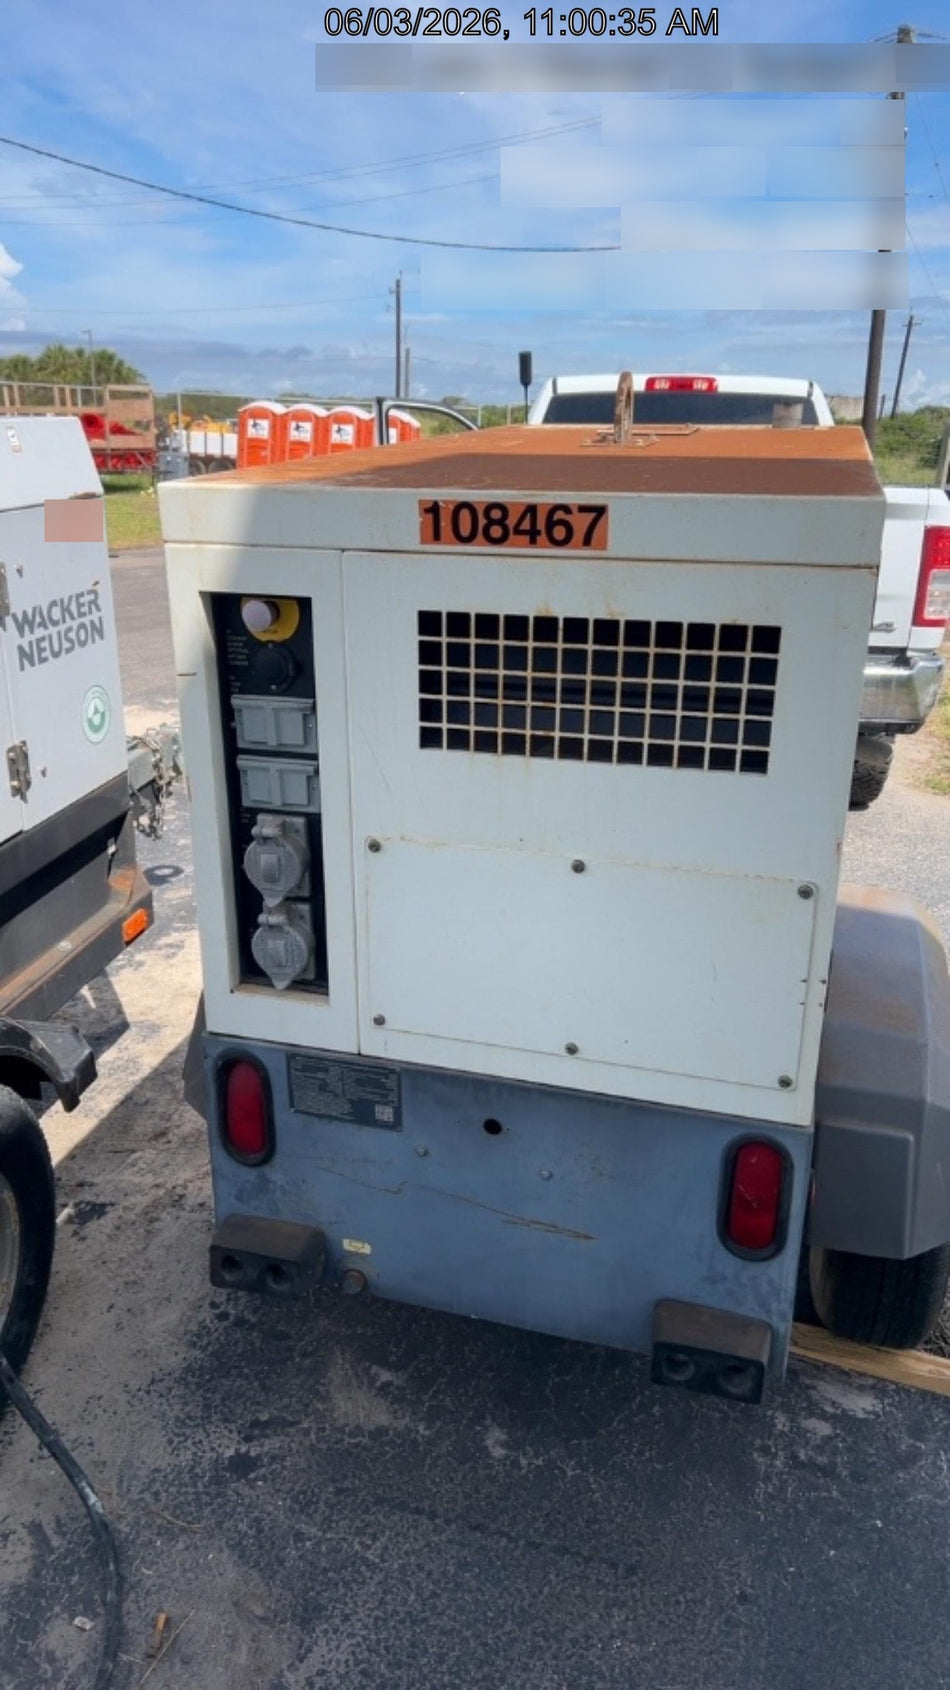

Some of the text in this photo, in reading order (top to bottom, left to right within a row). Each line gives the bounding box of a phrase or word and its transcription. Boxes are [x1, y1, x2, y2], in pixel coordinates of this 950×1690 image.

[423, 500, 607, 547] 108467
[10, 589, 102, 639] WACKER
[16, 616, 105, 672] NEUSON
